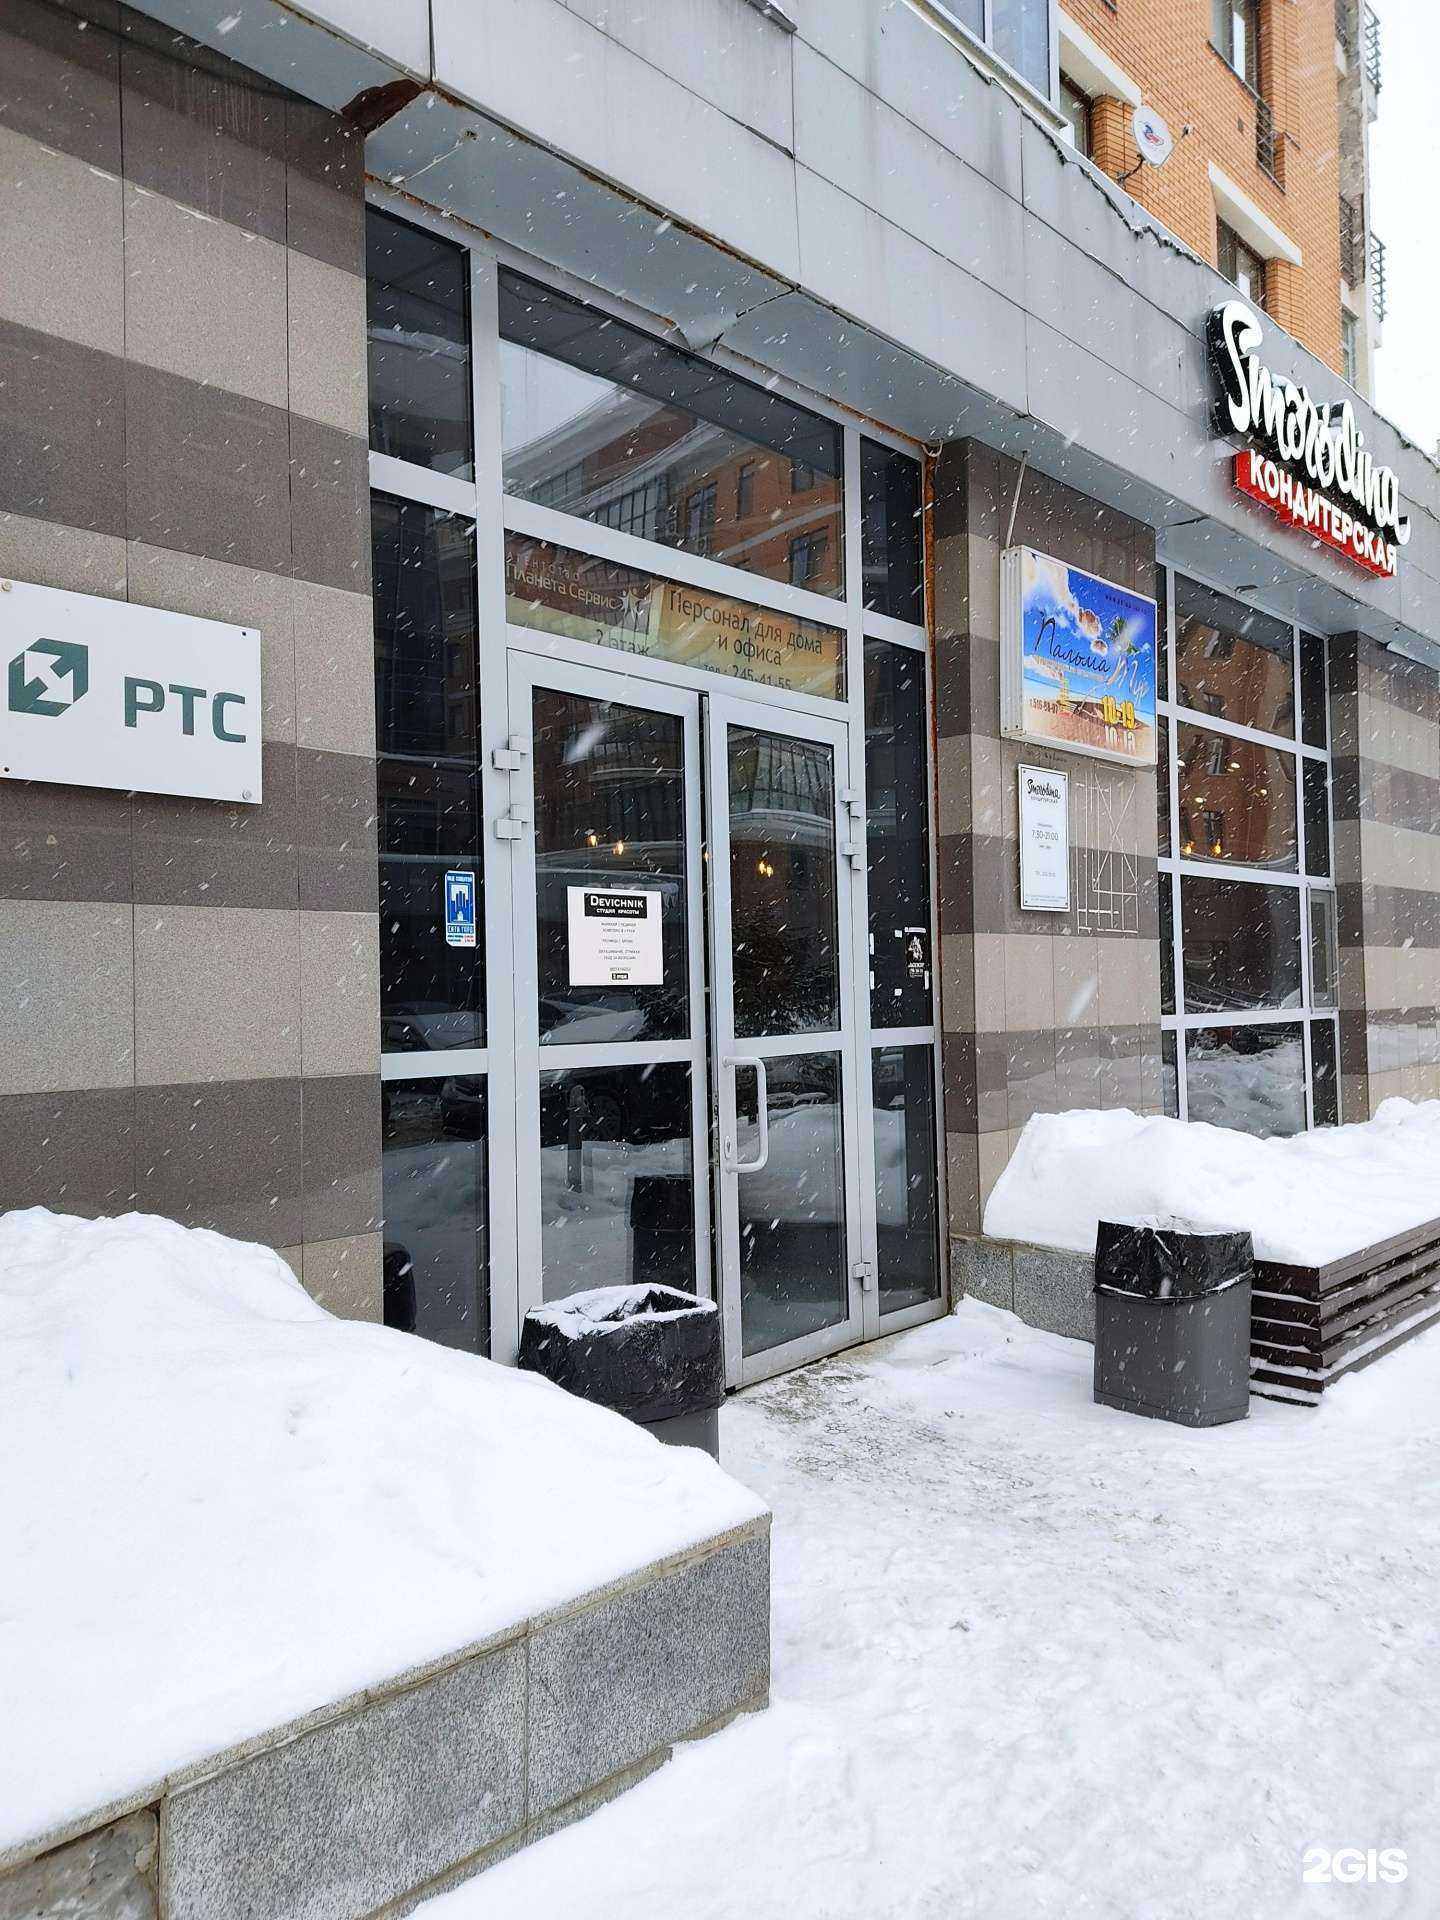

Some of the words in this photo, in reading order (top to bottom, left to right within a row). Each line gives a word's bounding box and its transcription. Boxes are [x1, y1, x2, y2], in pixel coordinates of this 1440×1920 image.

[1250, 449, 1397, 576] КОНДИТЕРСКАЯ
[506, 562, 567, 595] Планета
[569, 582, 618, 609] Сервис
[670, 588, 750, 634] Персонал
[755, 622, 782, 643] для
[786, 630, 823, 655] дома
[718, 634, 728, 649] и
[734, 637, 782, 666] офиса
[1033, 611, 1111, 674] Пальма
[124, 676, 247, 743] РТС
